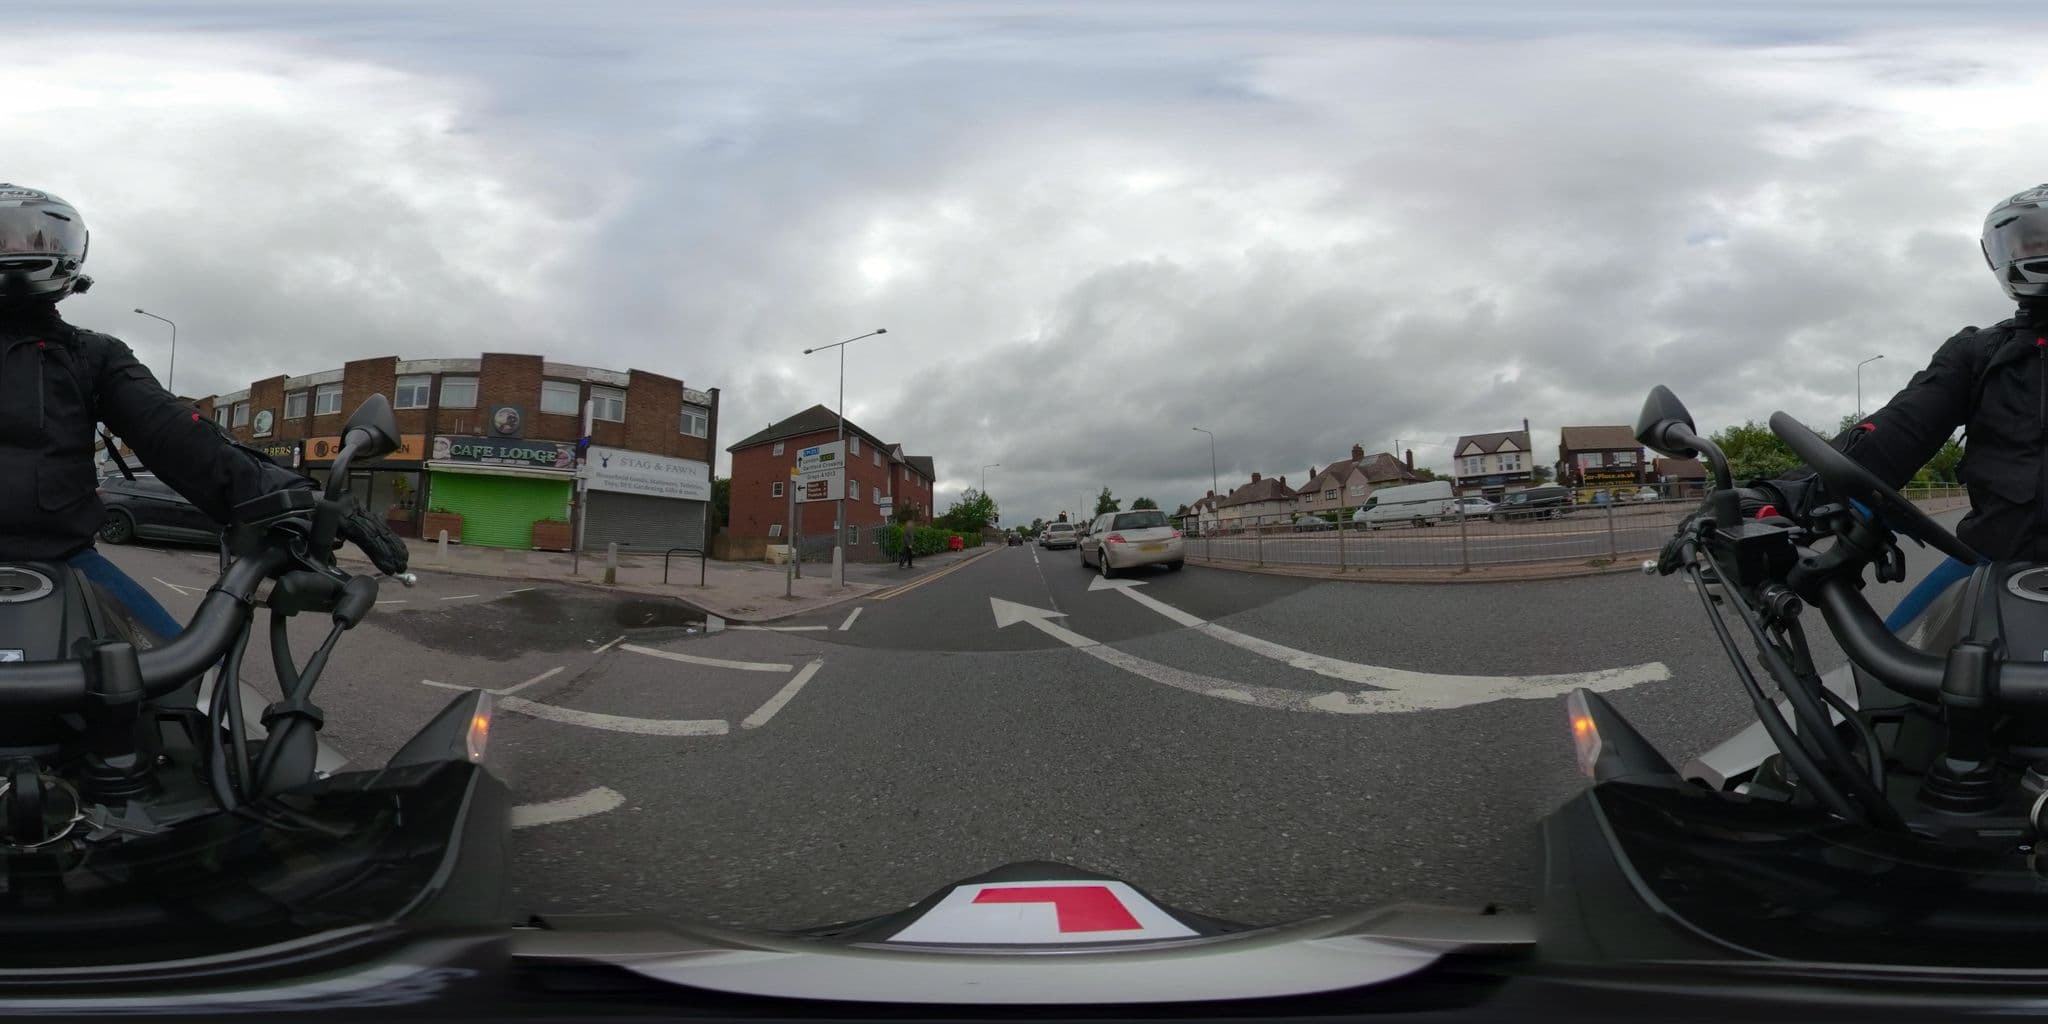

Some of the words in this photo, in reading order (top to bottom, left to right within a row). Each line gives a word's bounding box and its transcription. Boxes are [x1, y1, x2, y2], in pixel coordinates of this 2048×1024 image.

[450, 445, 494, 459] CAFE
[499, 447, 558, 463] LODGE
[620, 457, 651, 470] STAG
[653, 462, 665, 471] &
[665, 464, 697, 476] FAWN
